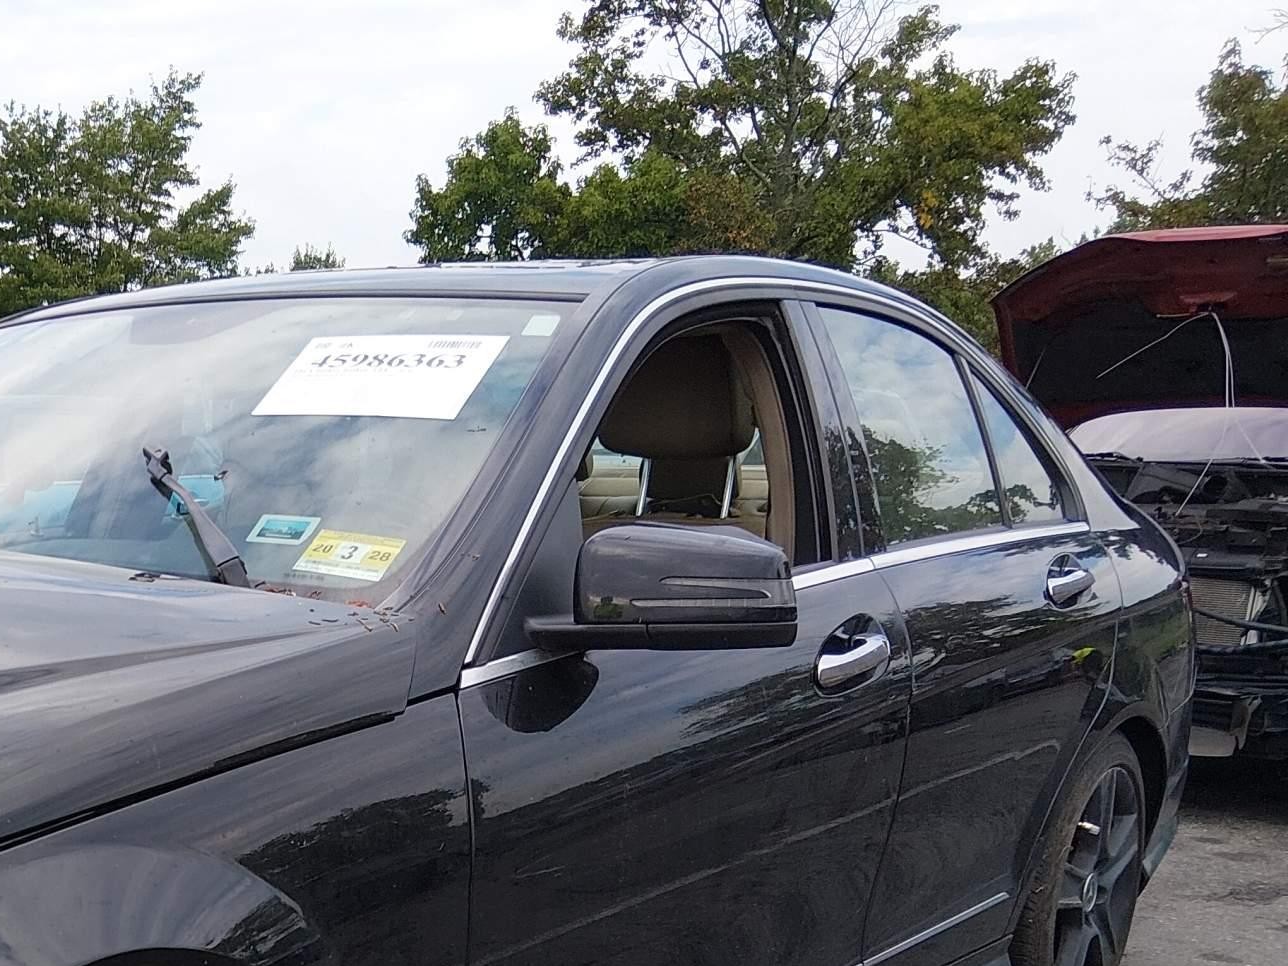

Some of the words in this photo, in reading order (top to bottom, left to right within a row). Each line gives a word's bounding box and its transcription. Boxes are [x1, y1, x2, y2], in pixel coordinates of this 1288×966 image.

[311, 353, 467, 368] 45986363
[312, 544, 333, 554] 20
[341, 545, 358, 560] 3
[368, 551, 392, 562] 28
